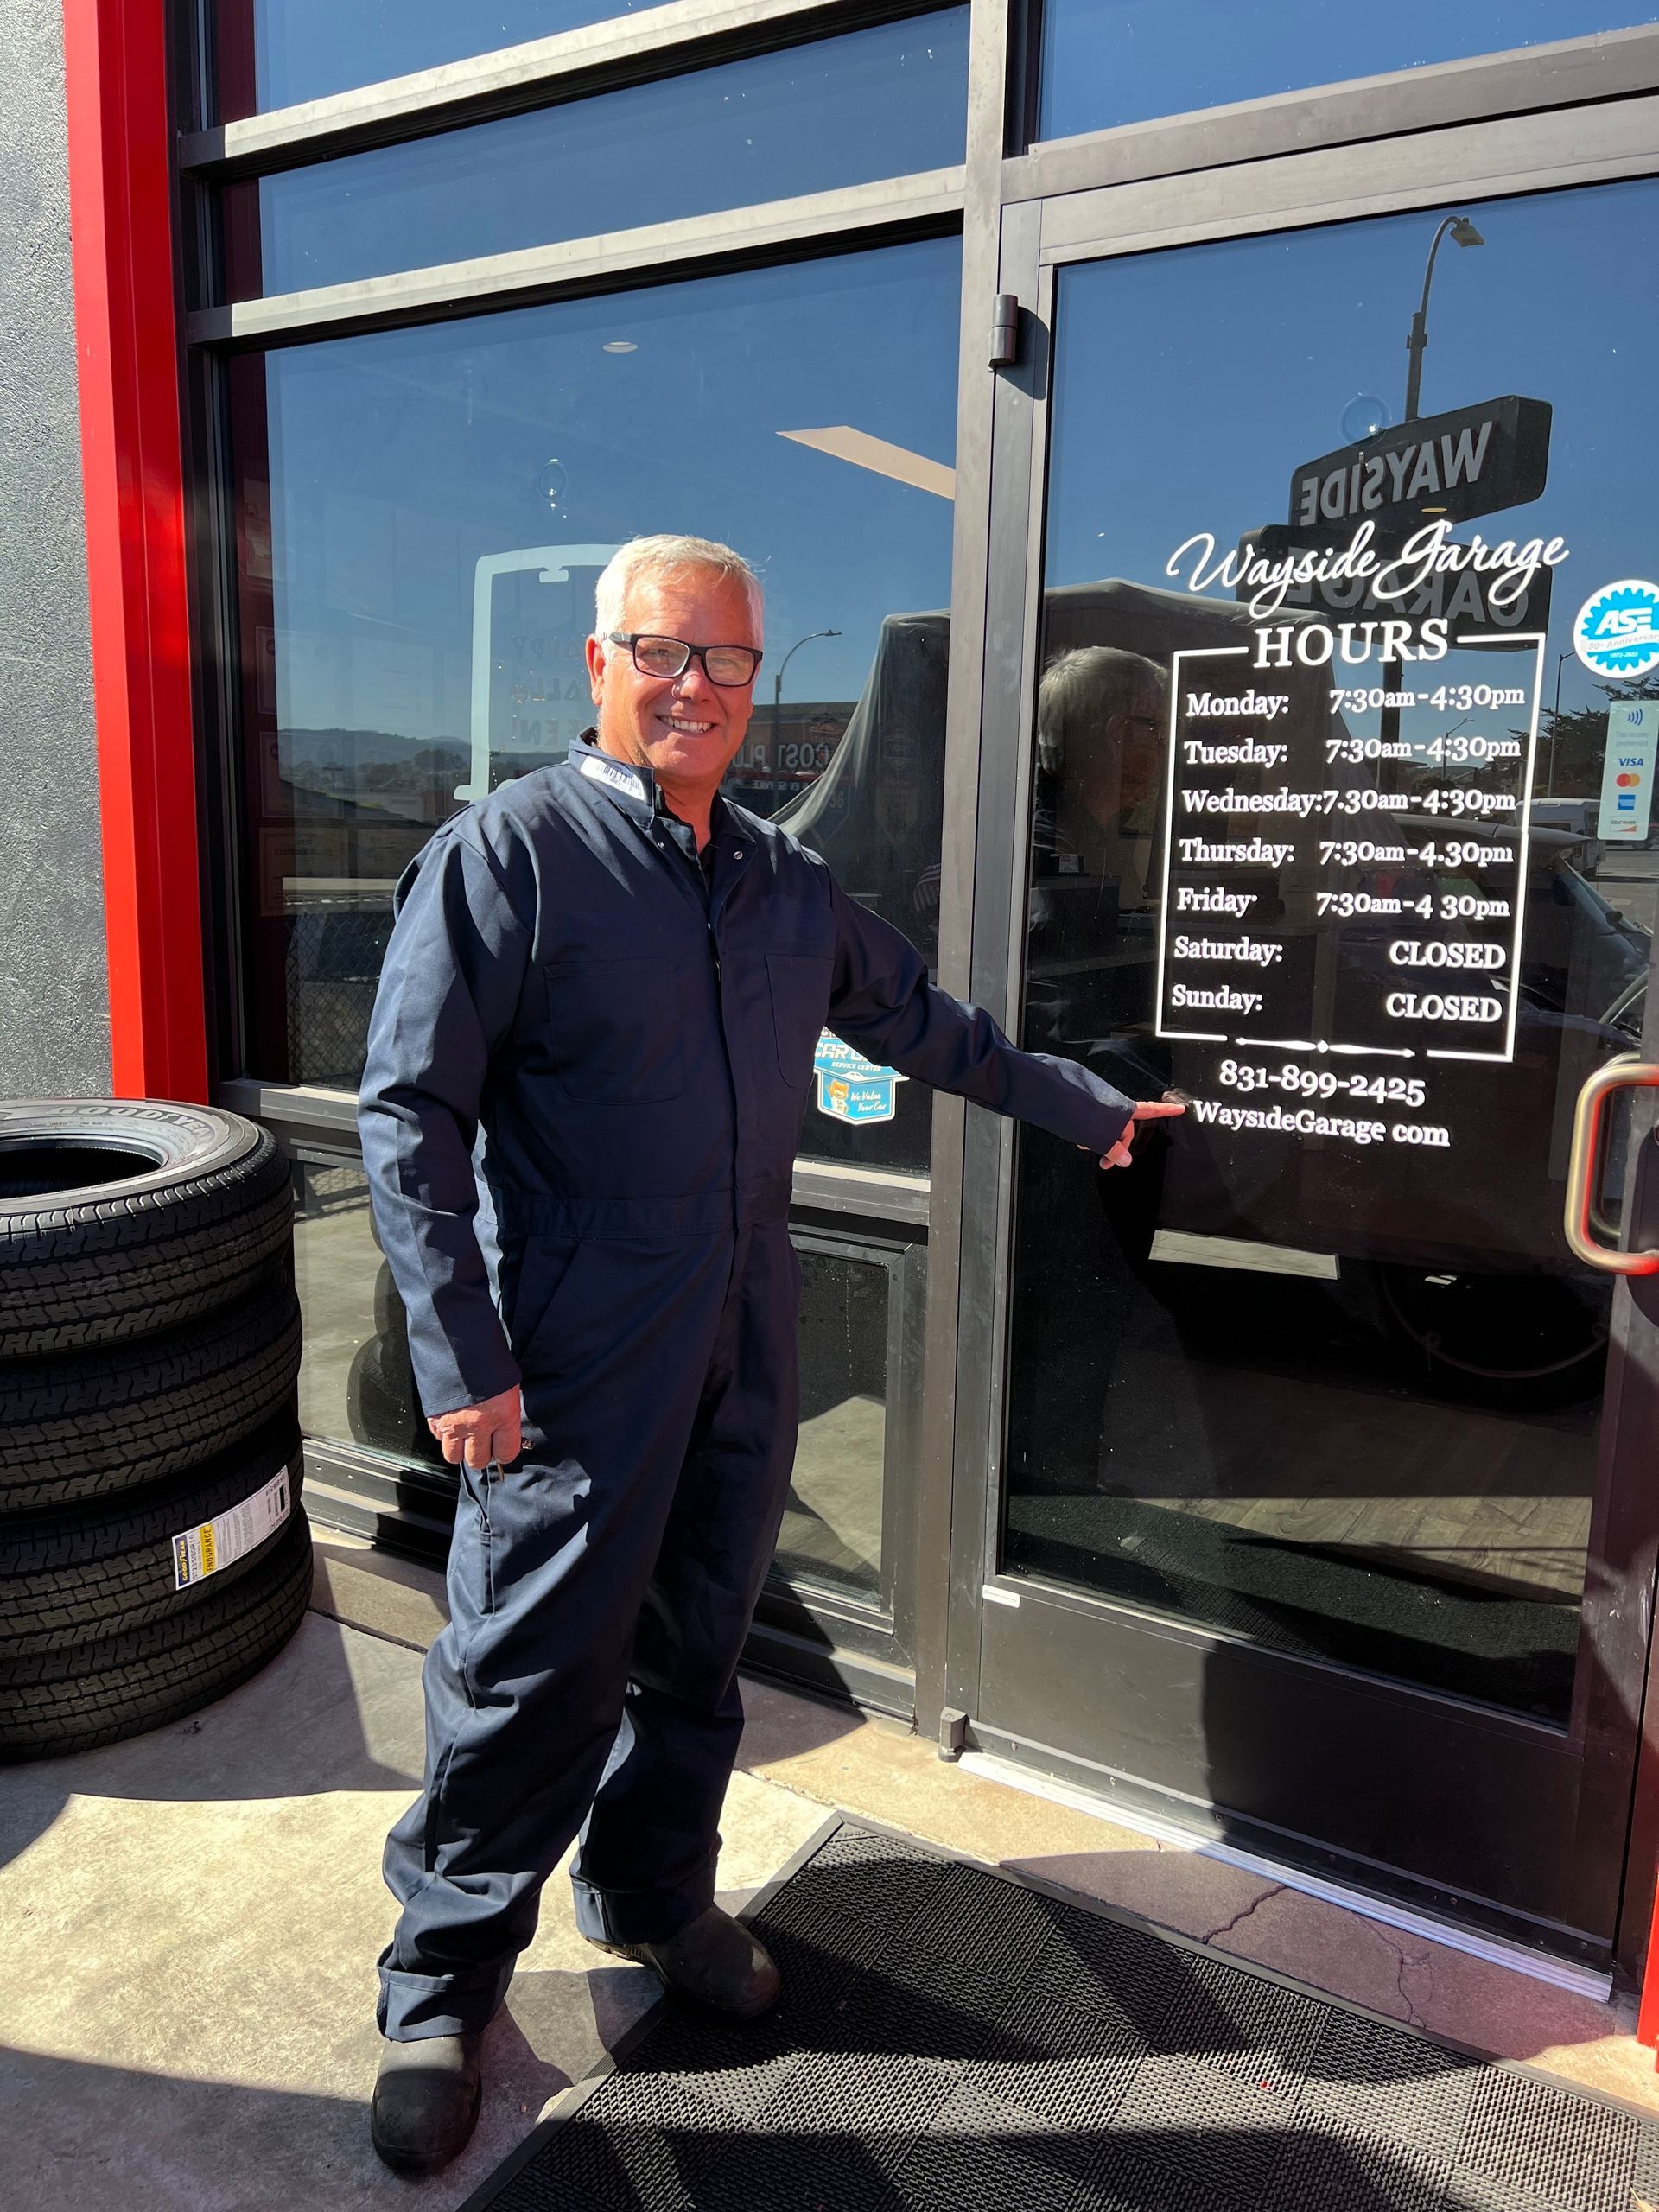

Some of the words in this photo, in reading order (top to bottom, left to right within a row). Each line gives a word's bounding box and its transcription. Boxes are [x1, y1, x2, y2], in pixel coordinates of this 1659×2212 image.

[1166, 520, 1382, 620] Wayside
[1372, 518, 1570, 607] Garage
[1595, 607, 1652, 635] ASE
[1253, 619, 1449, 668] HOURS
[1186, 689, 1289, 720] Monday:
[1330, 685, 1526, 714] 7:30am-4:30pm
[1184, 738, 1288, 768] Tuesday:
[1326, 737, 1522, 764] 7:30am-4:30pm
[1618, 758, 1643, 766] VISA
[1182, 787, 1323, 818] Wednesday:
[1179, 838, 1295, 868] Thursday:
[1174, 936, 1283, 966] Saturday:
[1389, 941, 1506, 969] CLOSED
[1172, 984, 1263, 1014] Sunday:
[1386, 993, 1503, 1022] CLOSED
[861, 1090, 881, 1101] Value
[1219, 1059, 1427, 1107] 831-899-2425
[858, 1103, 873, 1112] Your
[874, 1101, 888, 1111] Car
[179, 1540, 188, 1581] GOODYEAR
[203, 1528, 213, 1572] ENDURANCE
